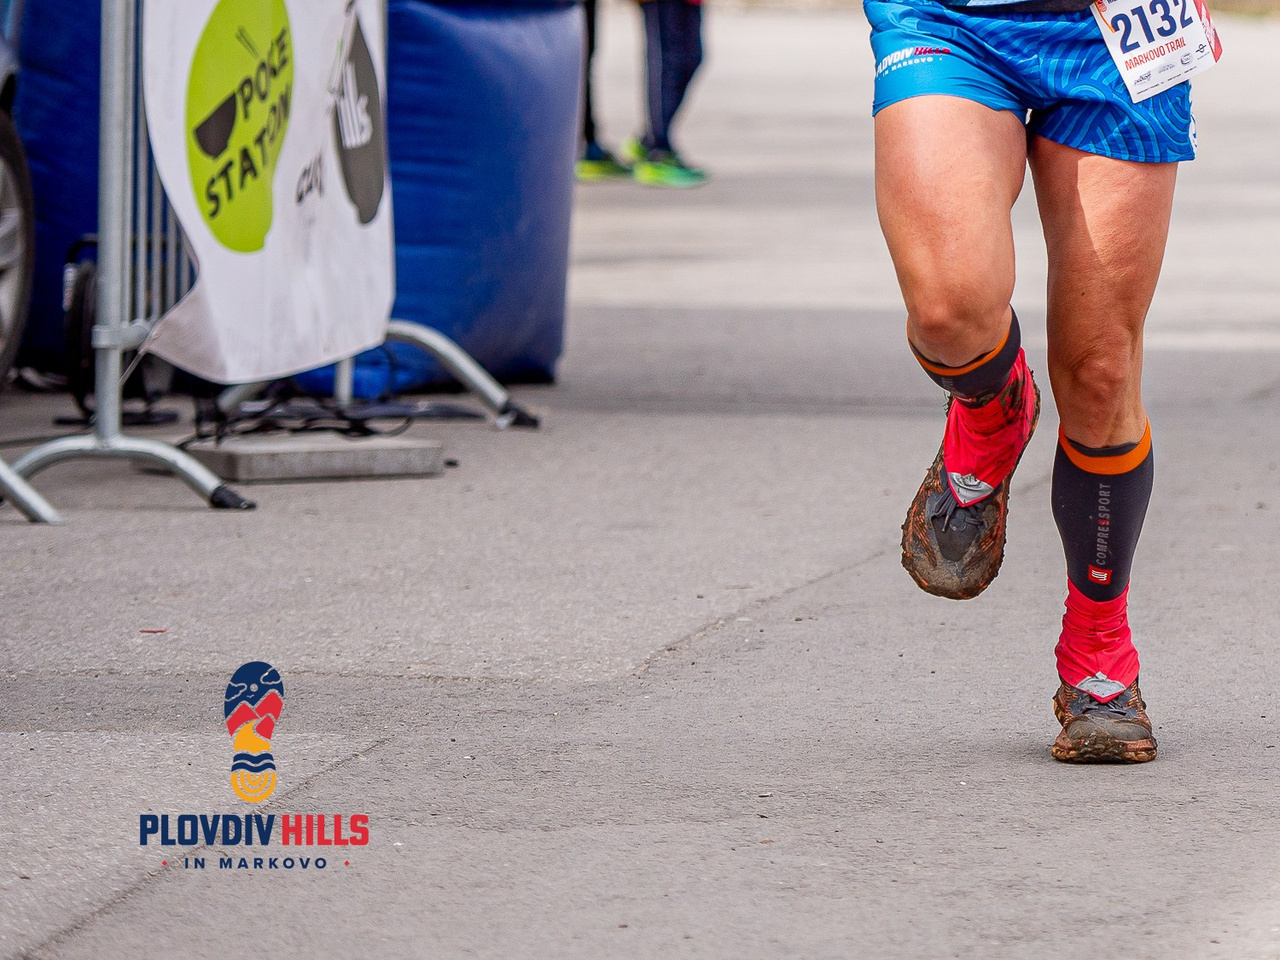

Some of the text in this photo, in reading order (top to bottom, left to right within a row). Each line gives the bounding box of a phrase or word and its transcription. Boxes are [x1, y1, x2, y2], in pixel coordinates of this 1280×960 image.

[891, 56, 933, 71] MARKOVO
[1124, 45, 1166, 71] MARKOVO
[1166, 36, 1187, 56] TRAIL
[205, 82, 290, 218] STATON
[1096, 483, 1111, 566] COMPRESSPORT
